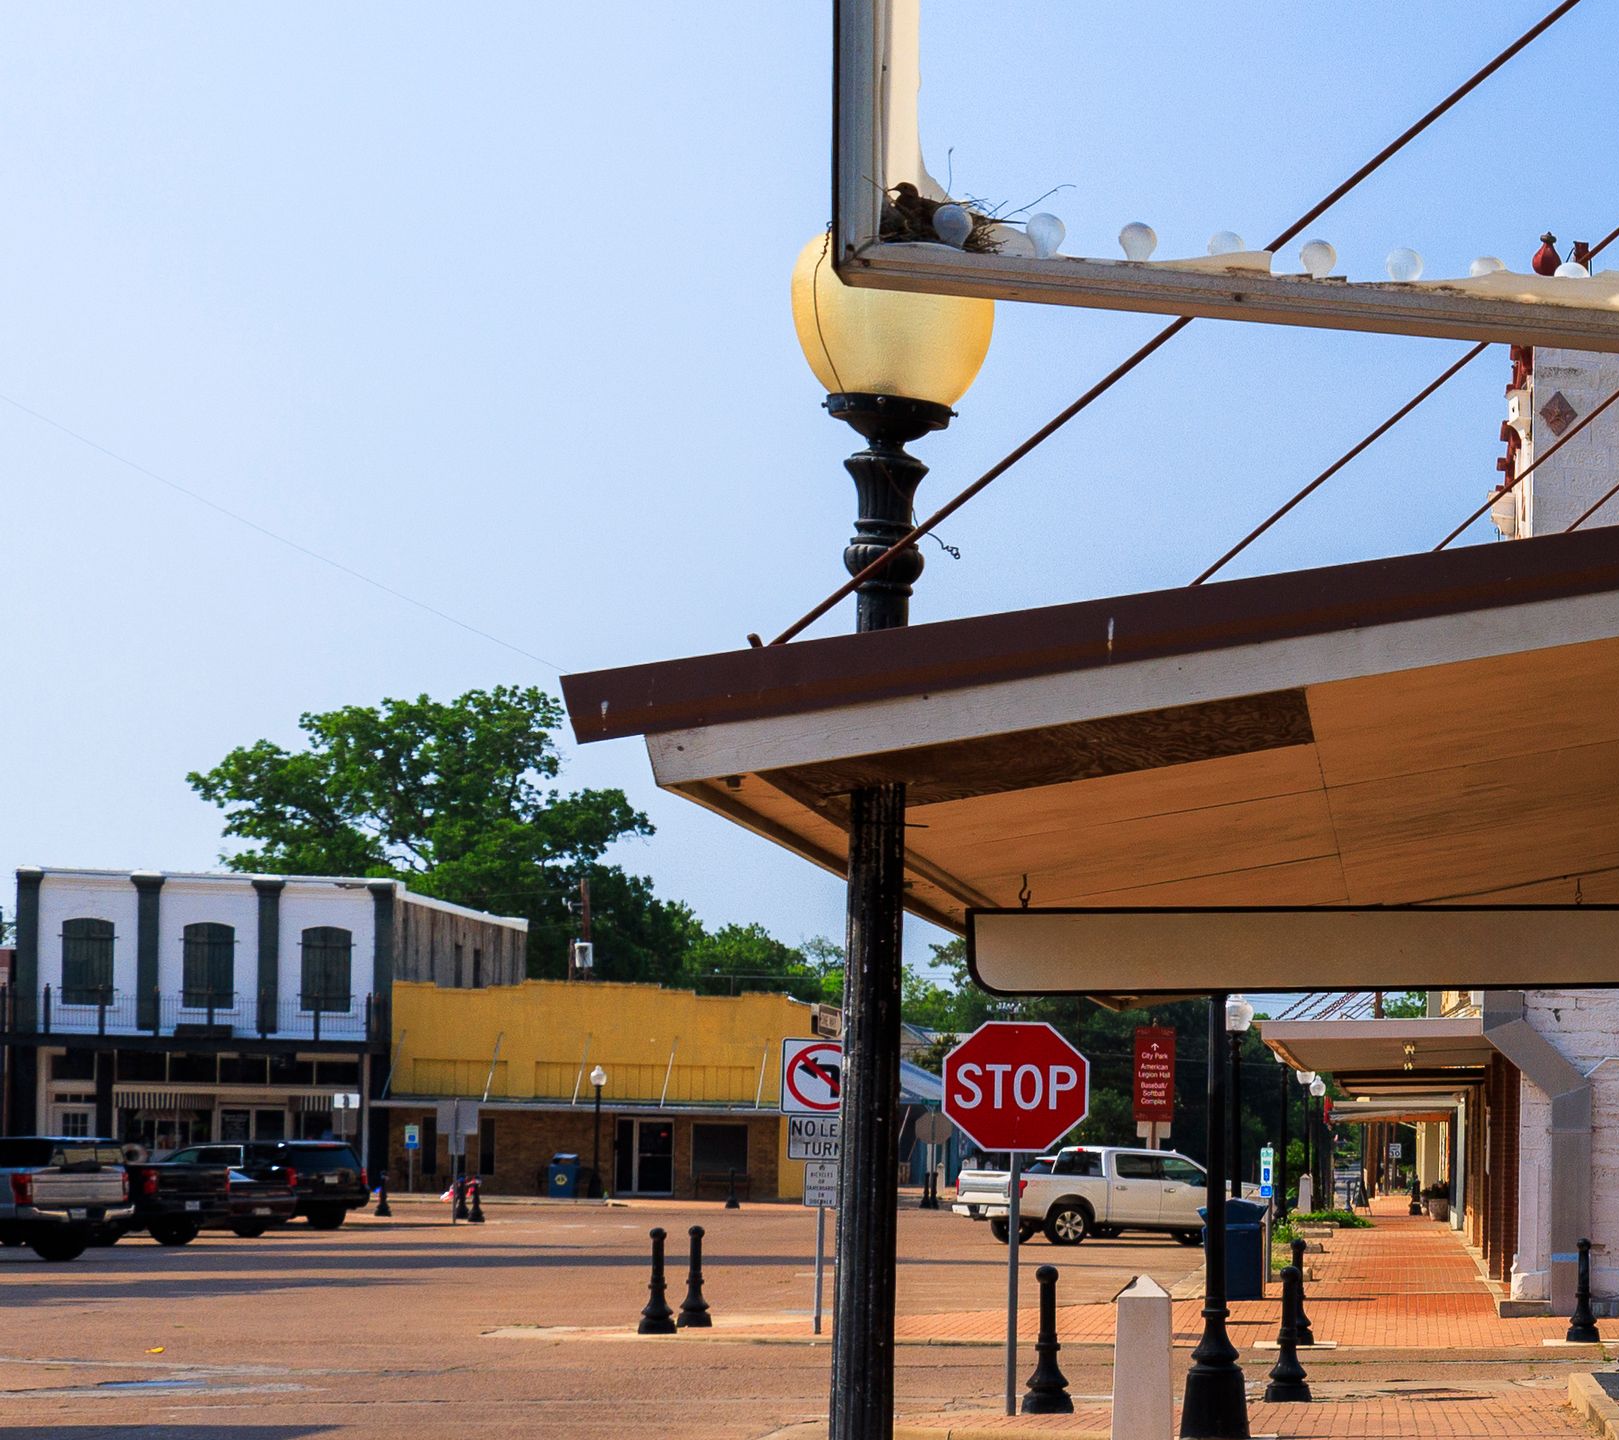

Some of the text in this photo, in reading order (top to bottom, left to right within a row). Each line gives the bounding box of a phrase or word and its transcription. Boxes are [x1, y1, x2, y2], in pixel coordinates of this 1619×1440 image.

[1141, 1052, 1153, 1060] City
[953, 1062, 1078, 1110] STOP
[792, 1120, 839, 1138] NO LE
